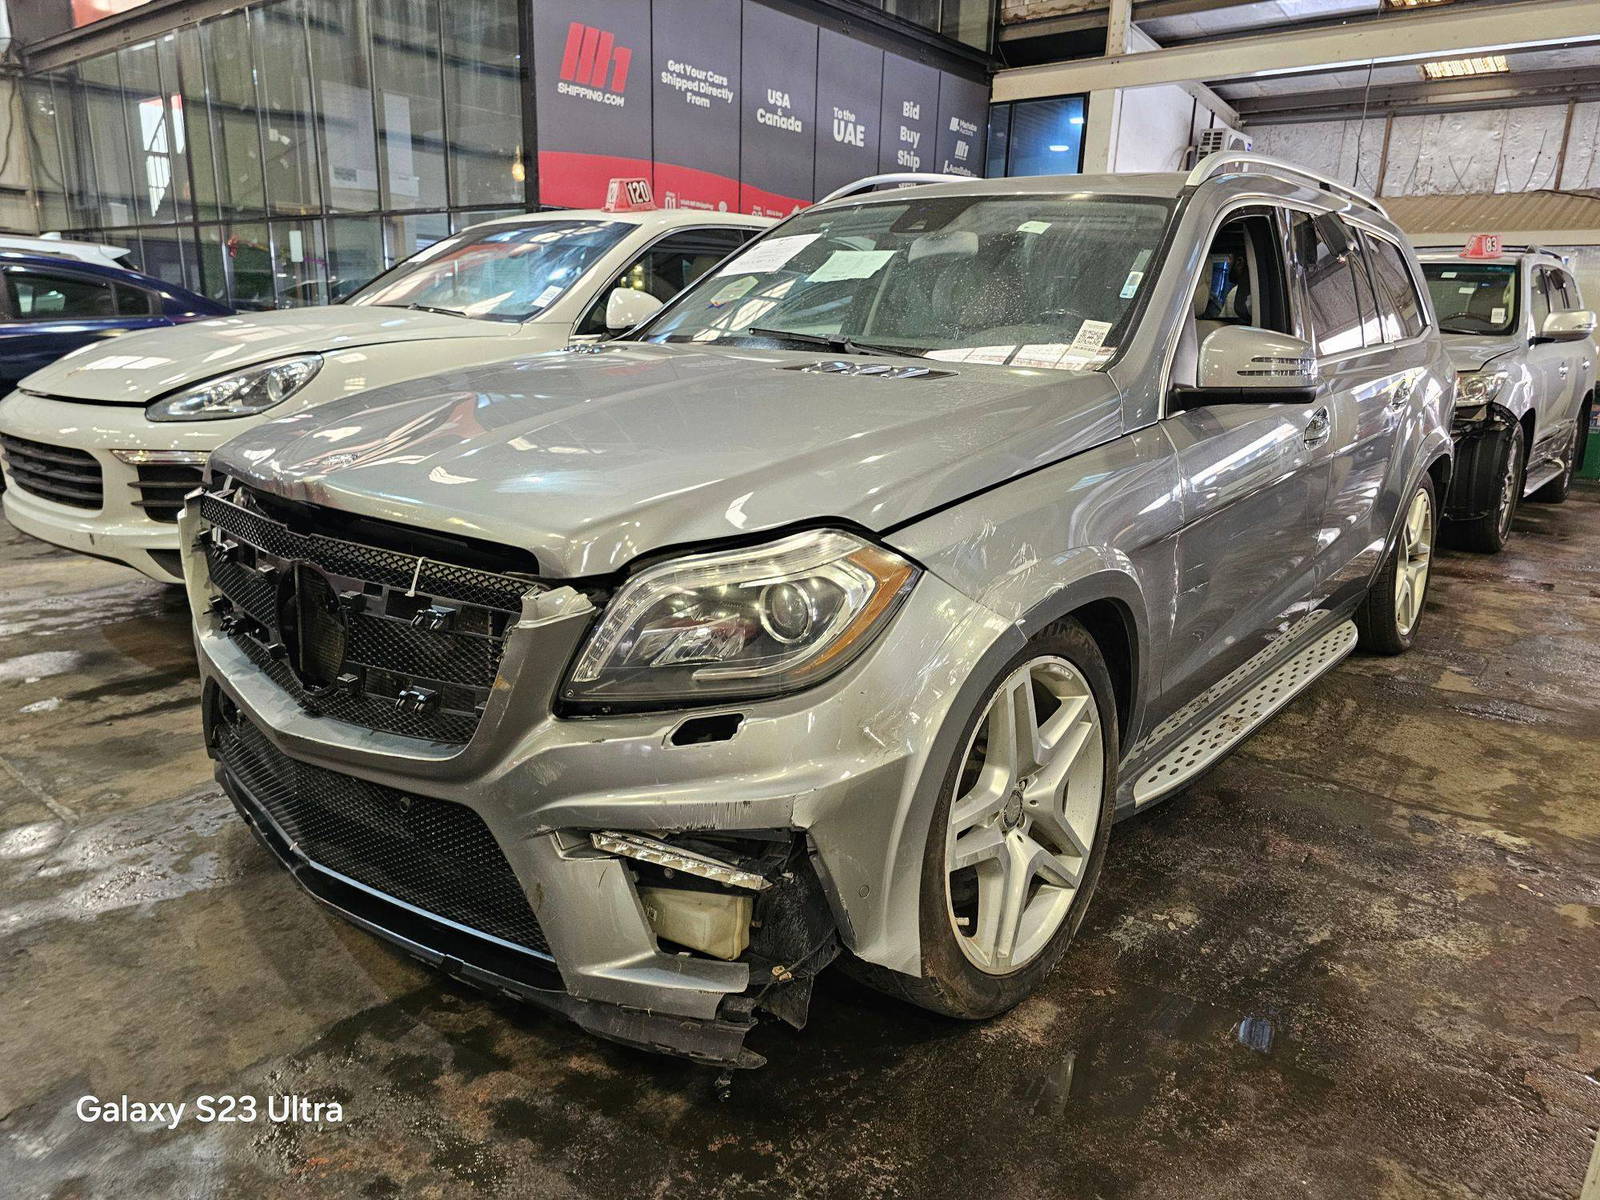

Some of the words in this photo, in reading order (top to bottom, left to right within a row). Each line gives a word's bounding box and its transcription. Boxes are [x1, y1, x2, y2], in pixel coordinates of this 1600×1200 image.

[667, 59, 685, 74] Get
[685, 64, 707, 80] Your
[707, 70, 728, 86] Cars
[557, 82, 625, 107] SHIPPING.COM
[661, 71, 699, 92] Shipped
[699, 81, 734, 104] Directly
[686, 91, 711, 108] From
[767, 88, 791, 109] USA
[756, 107, 802, 133] Canada
[833, 106, 843, 120] To
[843, 109, 856, 122] the
[902, 101, 920, 121] Bid
[833, 118, 866, 147] UAE
[900, 125, 921, 149] Buy
[897, 149, 920, 173] Ship
[626, 180, 651, 204] 120
